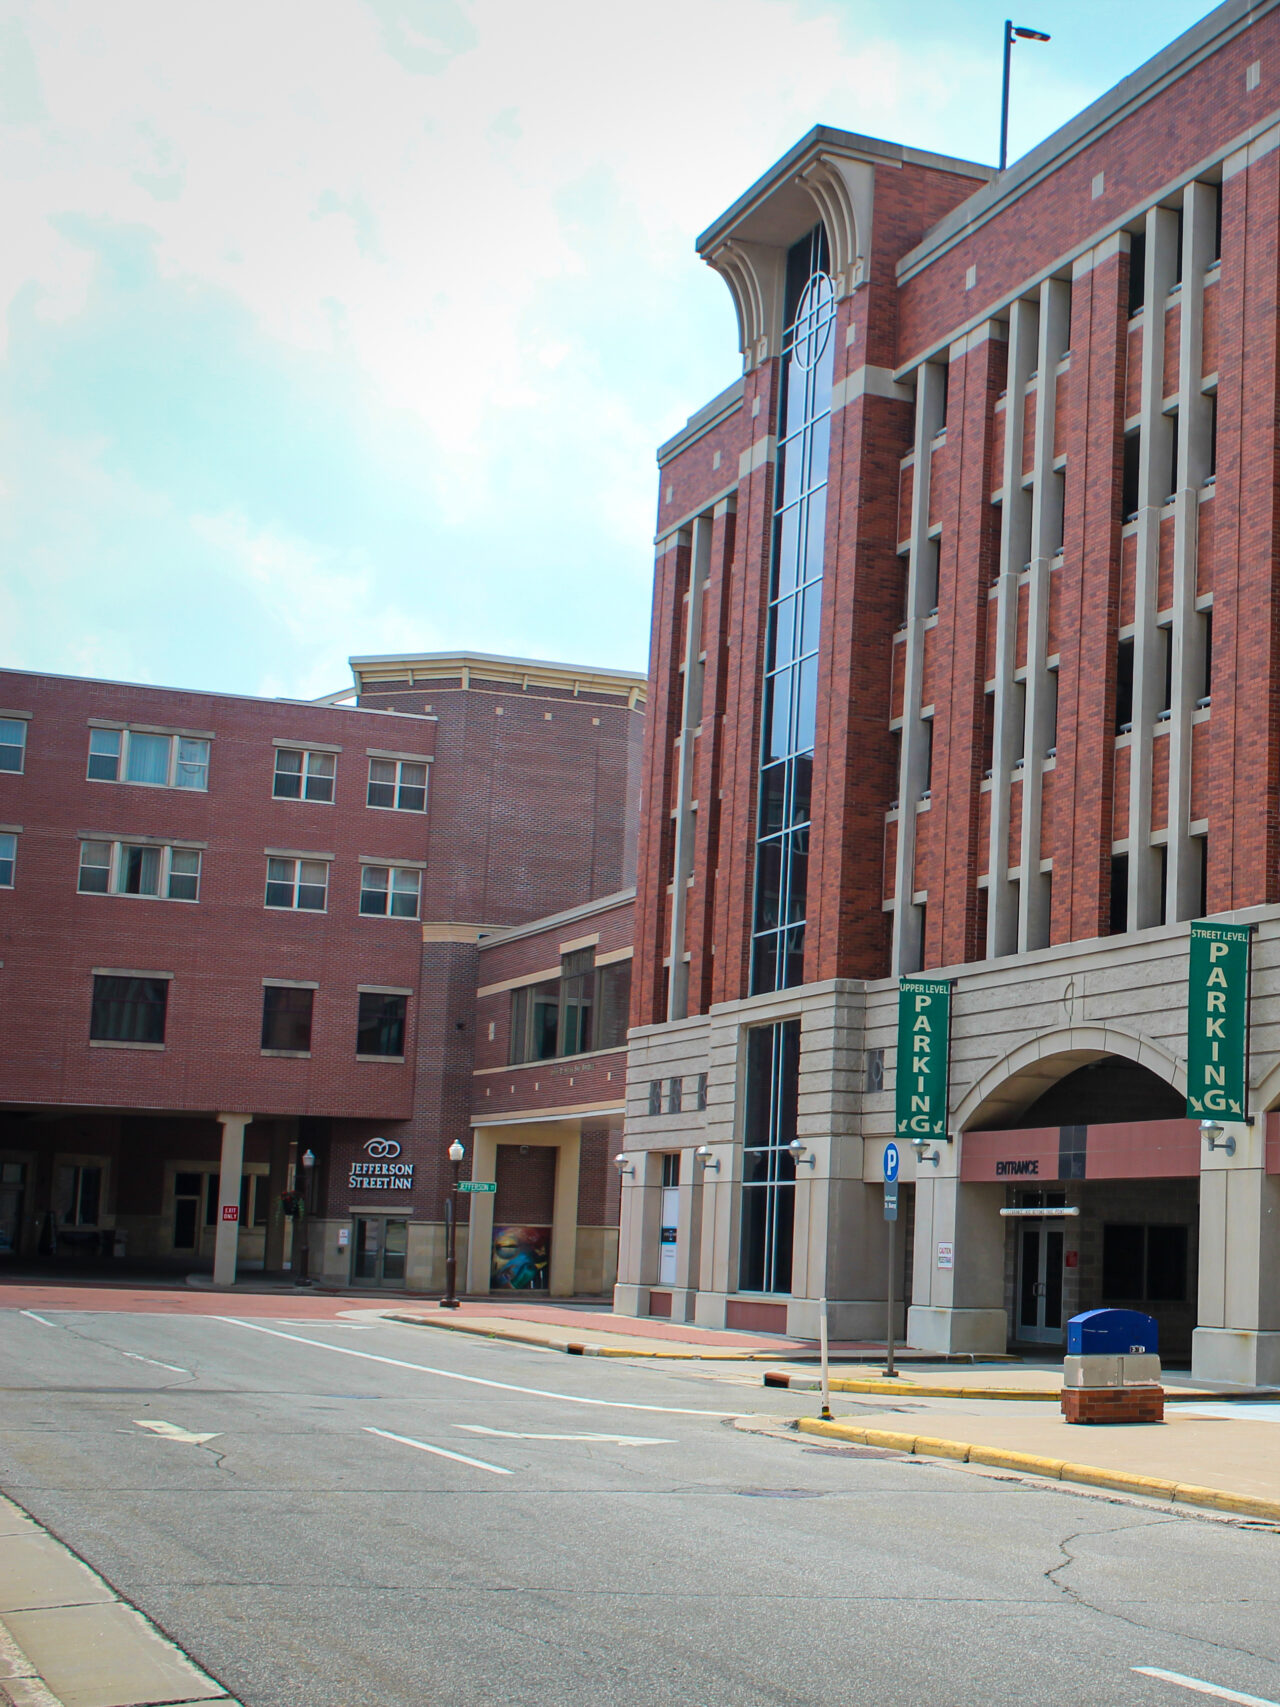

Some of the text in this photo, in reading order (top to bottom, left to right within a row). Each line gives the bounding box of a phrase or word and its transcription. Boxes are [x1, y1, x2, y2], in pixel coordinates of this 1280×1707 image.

[1192, 929, 1247, 942] STREET LEVEL
[900, 983, 948, 994] UPPER LEVEL
[1203, 942, 1229, 1111] PARKING
[910, 995, 932, 1132] PARKING
[887, 1149, 897, 1175] P
[996, 1160, 1039, 1176] ENTRANCE
[349, 1163, 414, 1176] JEFFERSON
[349, 1176, 412, 1189] STREET INN
